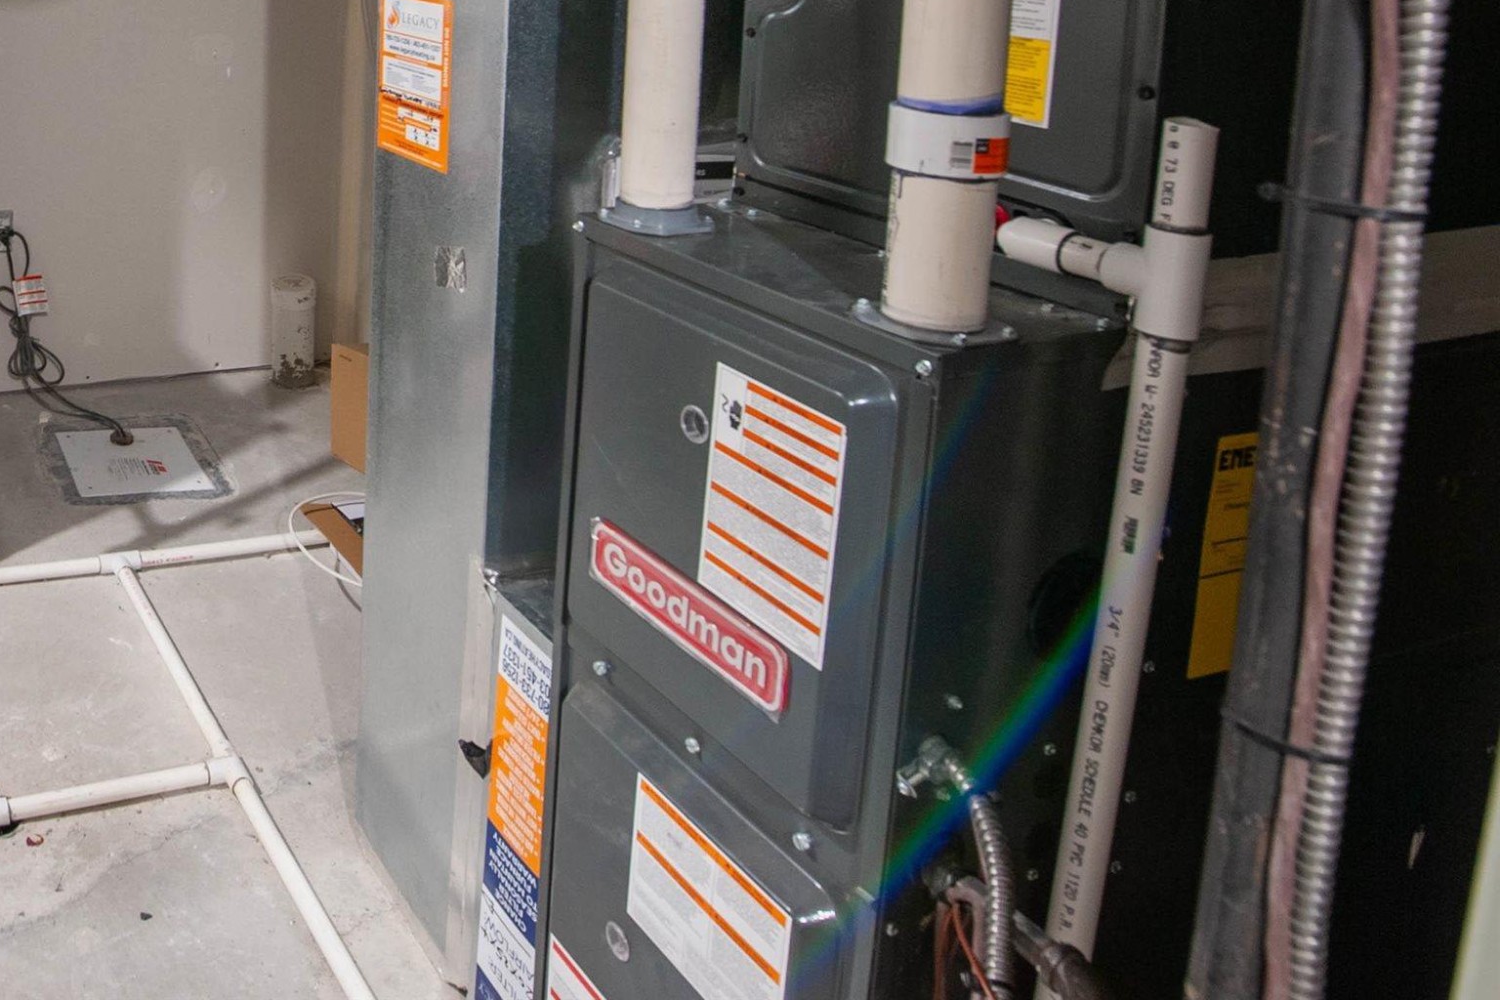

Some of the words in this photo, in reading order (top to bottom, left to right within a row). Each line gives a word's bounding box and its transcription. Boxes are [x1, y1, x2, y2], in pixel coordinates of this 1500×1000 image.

[401, 11, 440, 31] LEGACY
[1161, 180, 1175, 206] DEG
[604, 543, 766, 689] Goodman
[1074, 821, 1089, 839] 40
